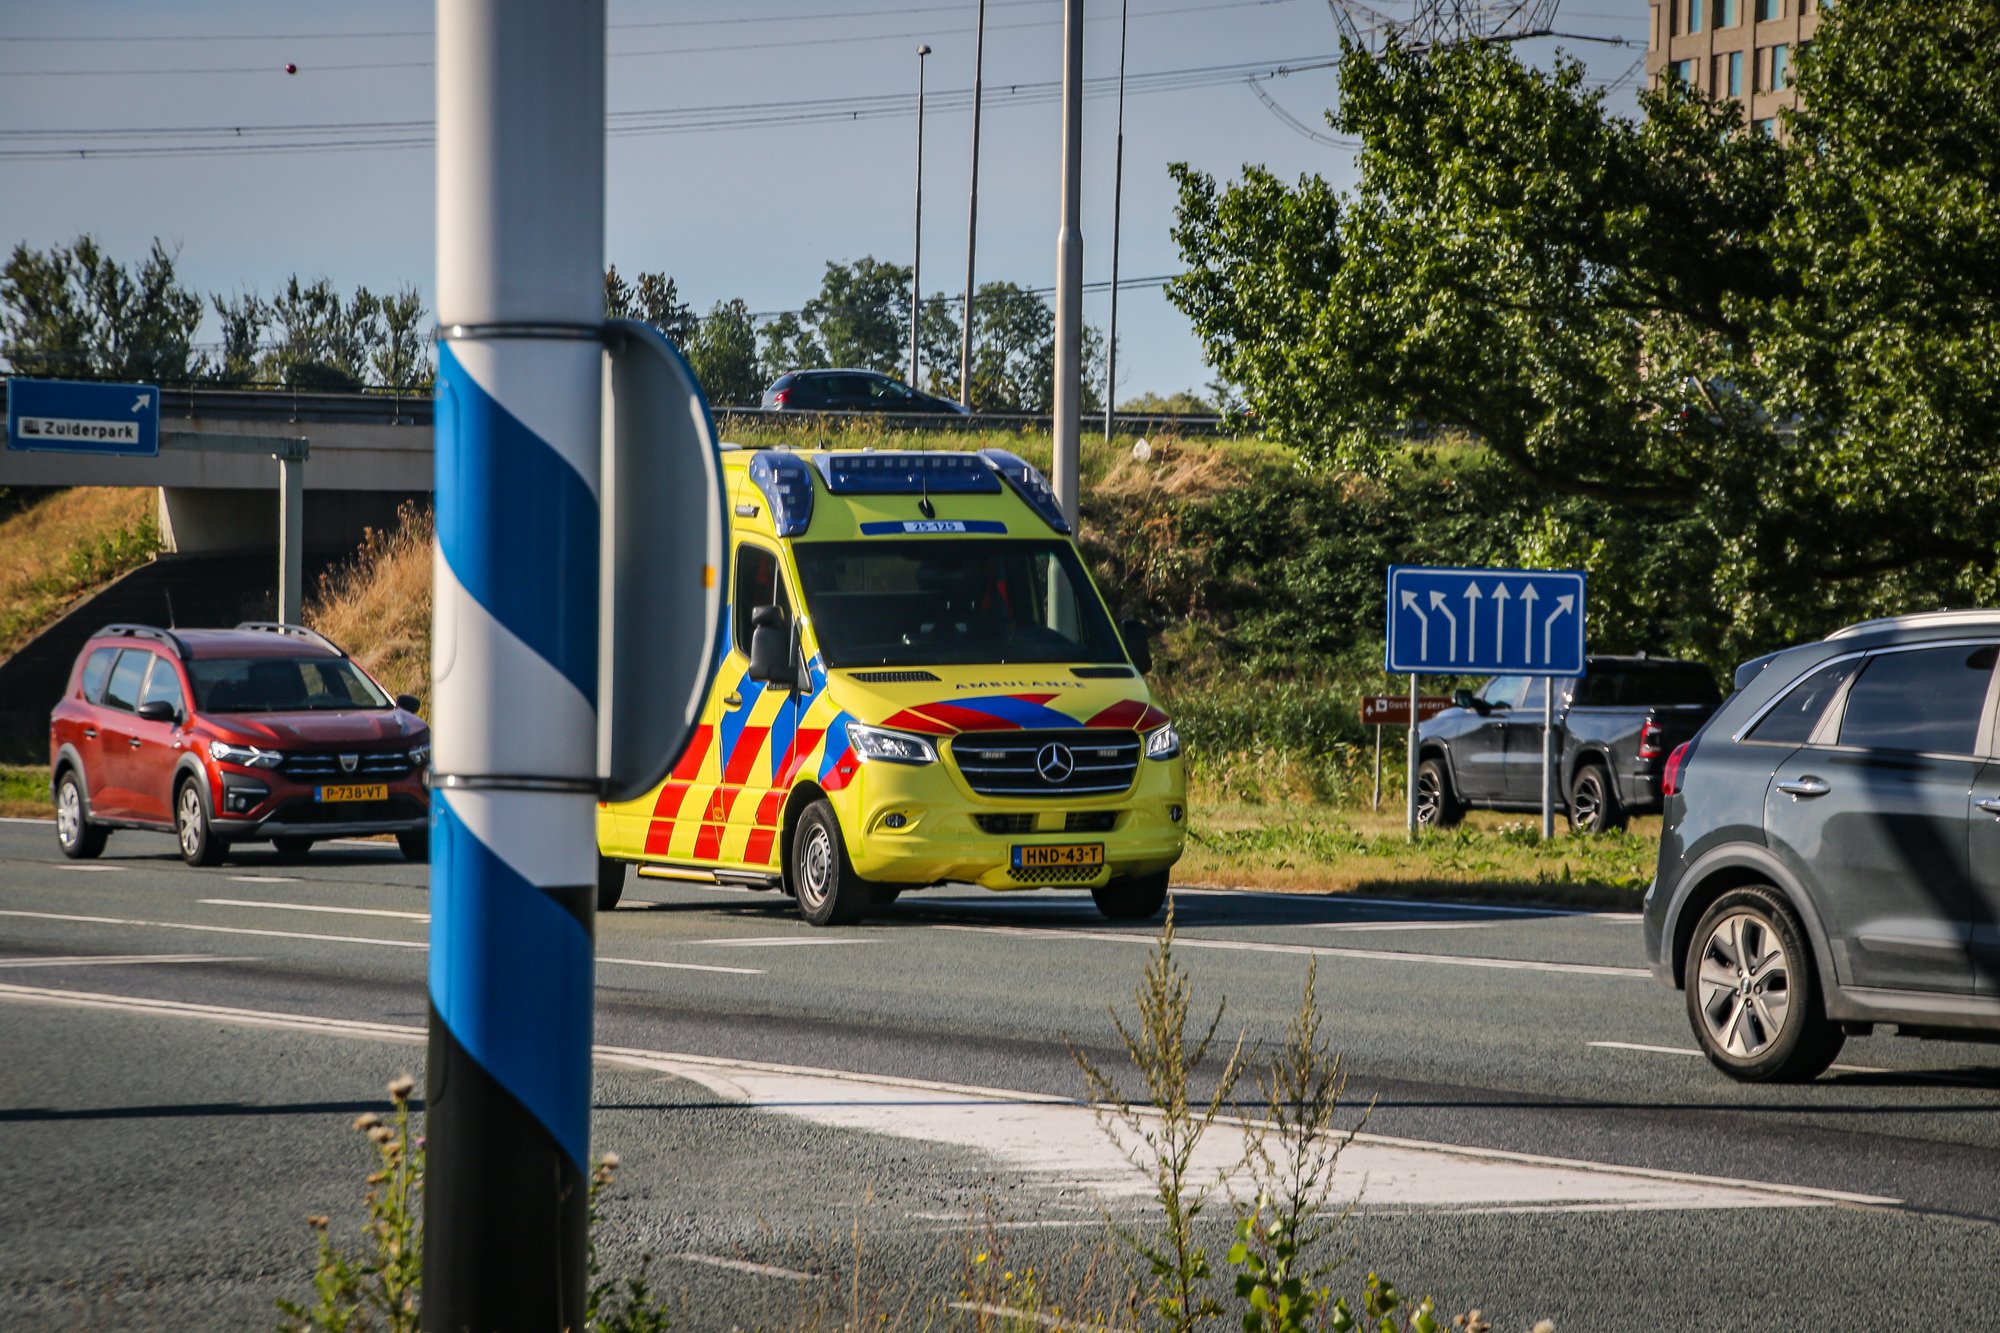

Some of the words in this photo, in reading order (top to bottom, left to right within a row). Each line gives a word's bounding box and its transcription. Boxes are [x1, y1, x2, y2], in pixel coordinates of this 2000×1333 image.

[45, 421, 133, 439] Zuiderpark
[955, 681, 1086, 690] AMBULANCE
[326, 786, 382, 799] P-738-VT
[1026, 847, 1098, 864] HND-43-T
